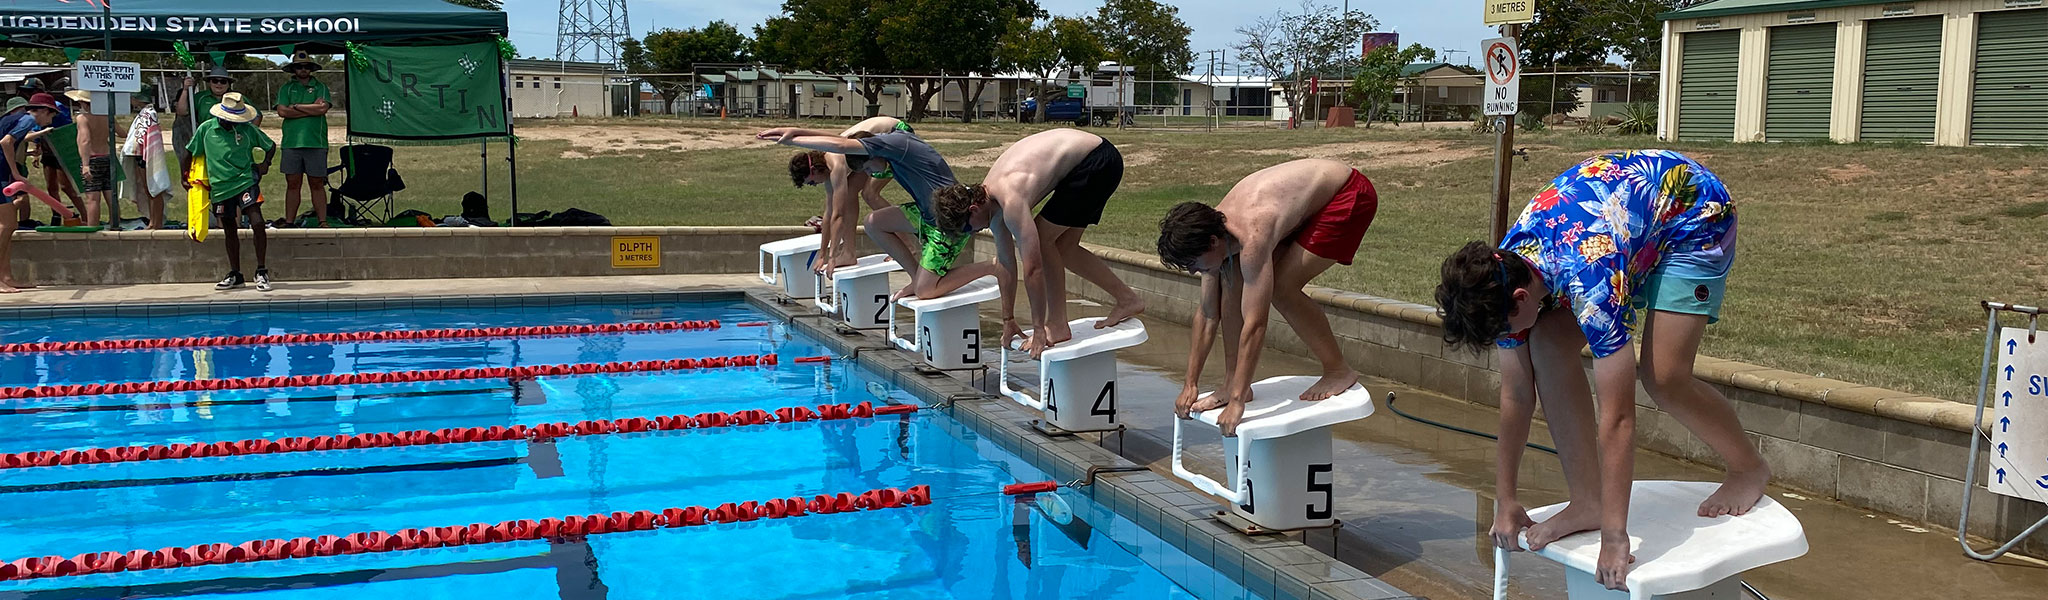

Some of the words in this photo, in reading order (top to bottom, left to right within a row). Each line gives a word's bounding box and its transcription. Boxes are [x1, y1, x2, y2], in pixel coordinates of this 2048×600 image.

[1491, 4, 1496, 14] 3
[1496, 1, 1526, 13] METRES
[165, 16, 252, 34] STATE
[259, 17, 368, 34] SCHOOL
[84, 71, 94, 79] AT
[95, 72, 112, 80] THIS
[99, 79, 115, 88] 3M
[1495, 86, 1507, 100] NO
[1486, 101, 1515, 112] RUNNING
[625, 254, 653, 262] METRES
[842, 292, 851, 323] 2
[874, 294, 889, 325] 2
[923, 325, 933, 362] 3
[962, 328, 980, 364] 3
[2028, 375, 2048, 397] S
[1047, 378, 1058, 421] 4
[1090, 380, 1117, 424] 4
[1306, 463, 1333, 520] 5
